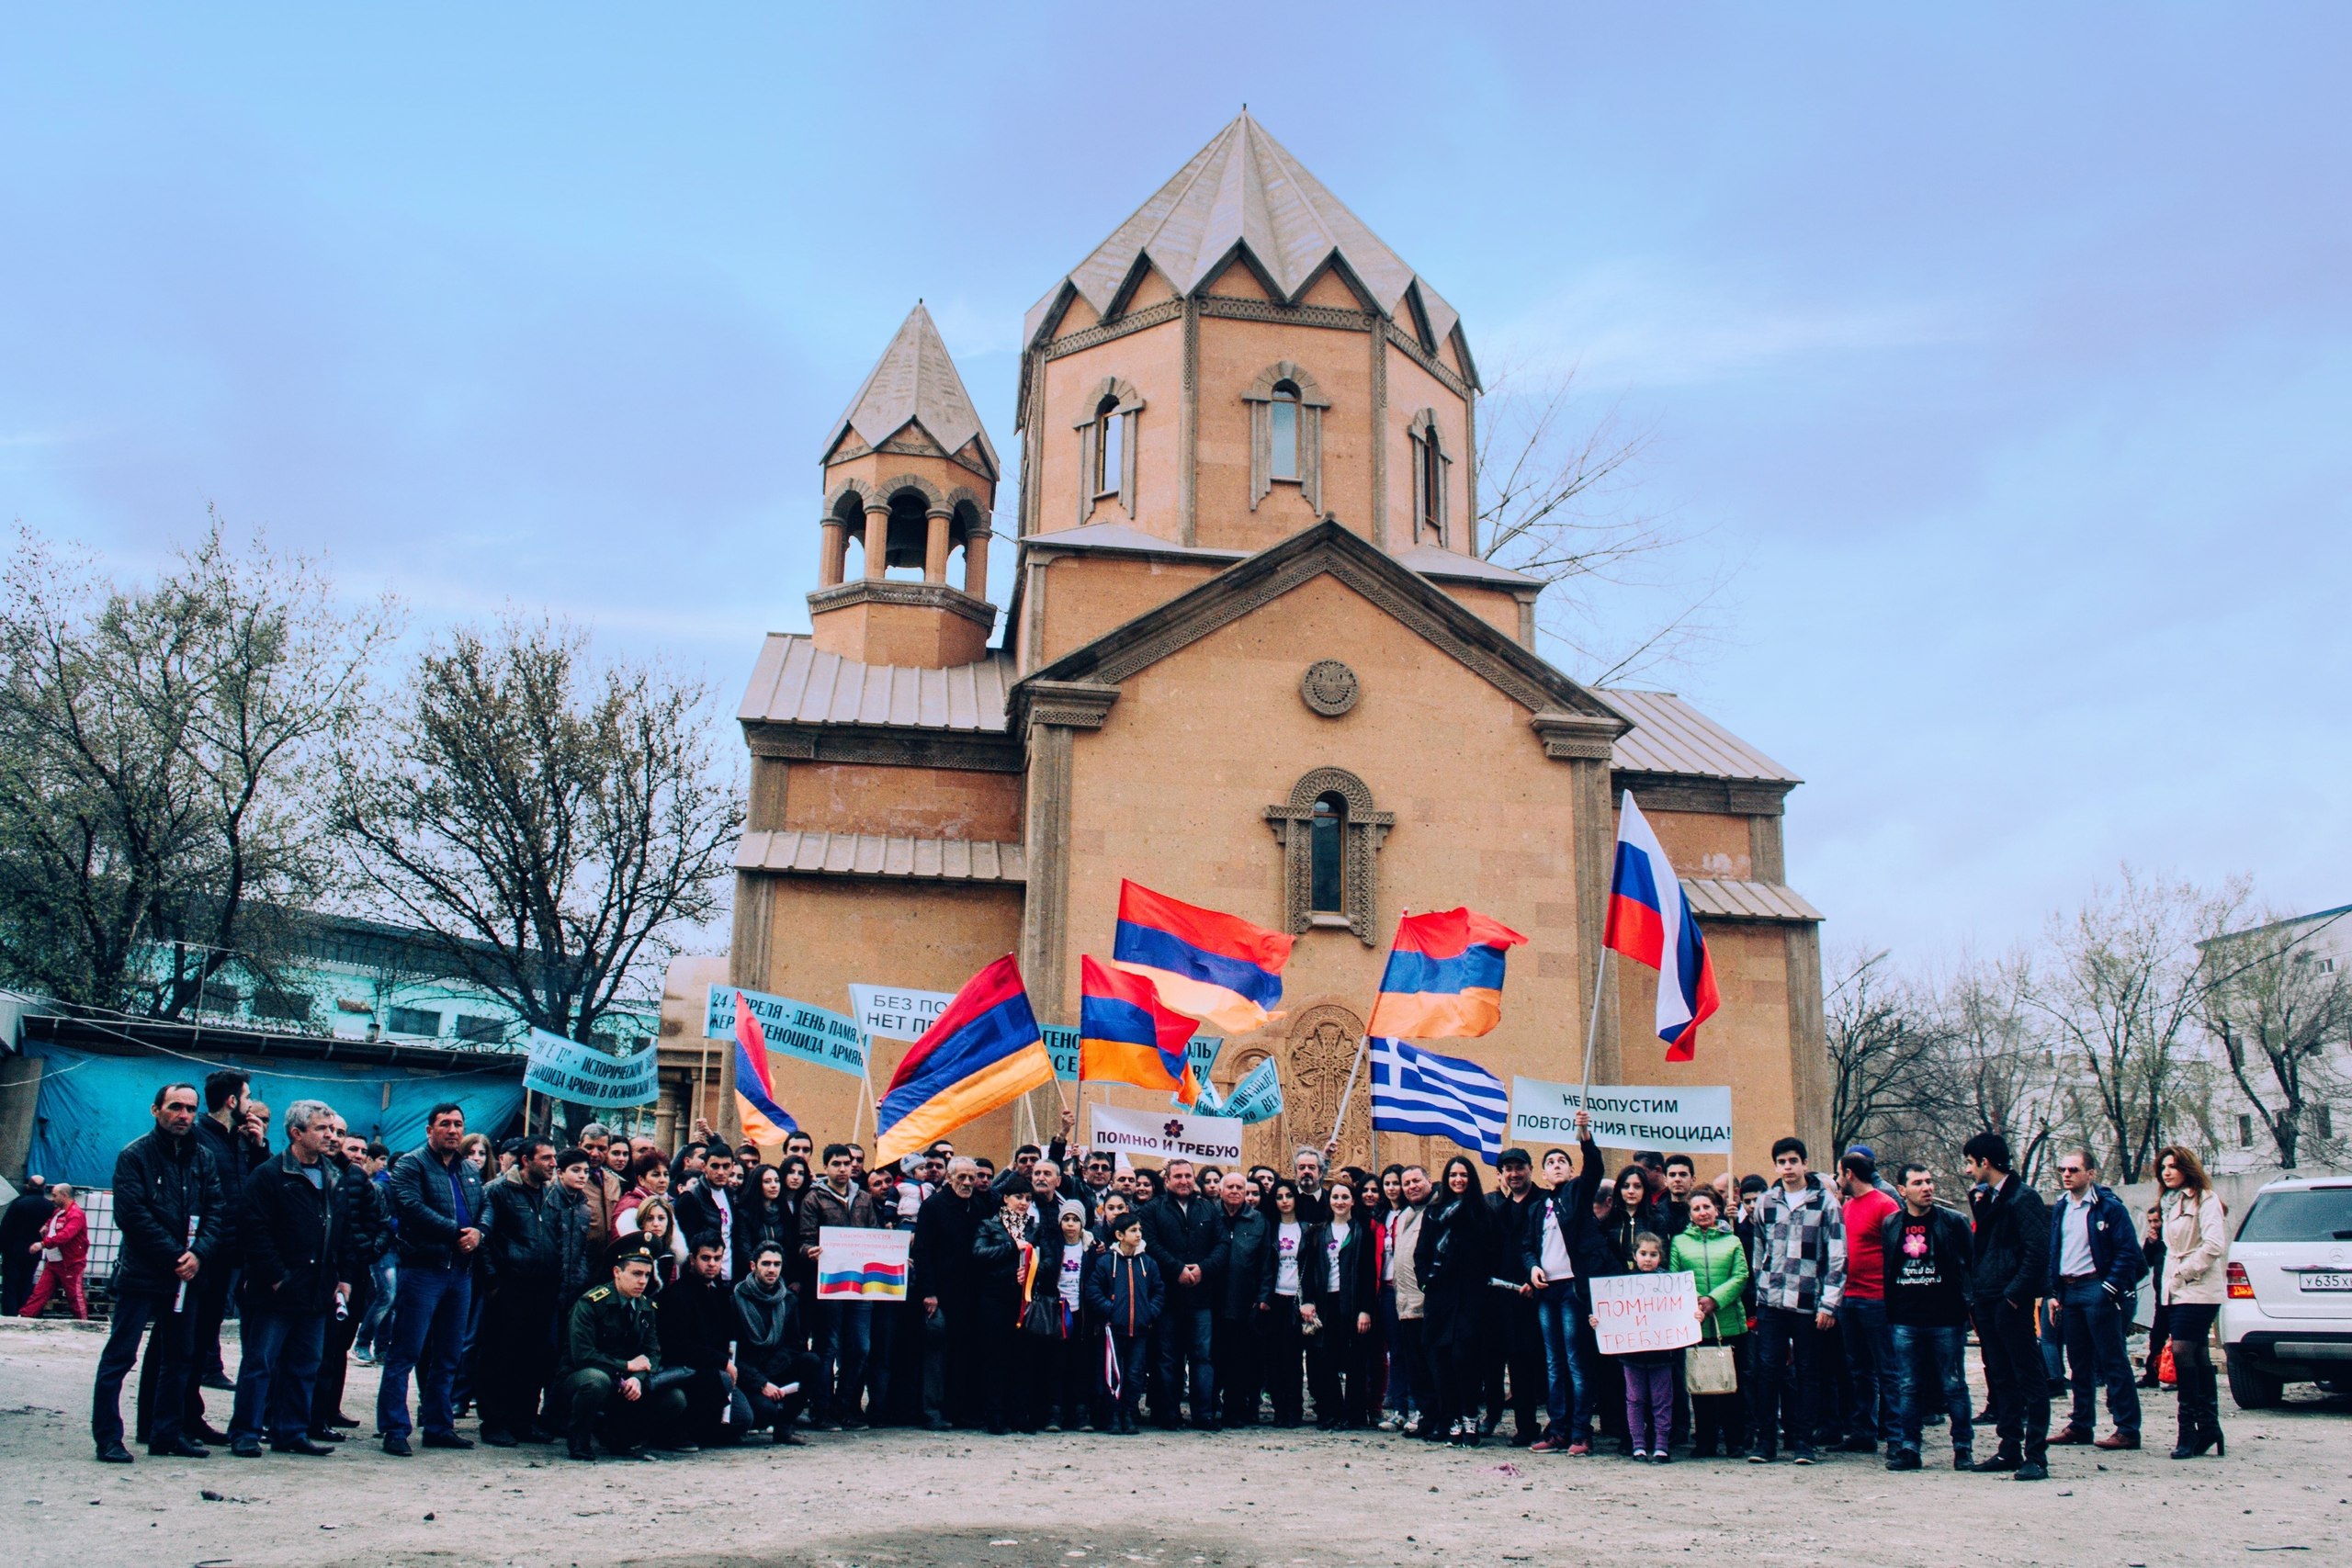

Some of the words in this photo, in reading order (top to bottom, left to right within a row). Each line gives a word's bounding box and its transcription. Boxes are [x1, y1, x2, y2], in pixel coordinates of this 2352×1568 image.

[874, 994, 912, 1011] БЕЗ
[710, 992, 729, 1009] 24
[792, 1010, 826, 1032] ДЕНЬ
[829, 1020, 868, 1047] ПАМЯИ
[866, 1011, 907, 1031] НЕТ
[566, 1075, 600, 1098] АРМЯН
[599, 1084, 608, 1099] В
[1562, 1093, 1581, 1107] НЕ
[1587, 1098, 1679, 1113] ДОПУСТИМ
[1097, 1130, 1158, 1149] ПОМНЮ
[1162, 1139, 1173, 1152] И
[1177, 1141, 1239, 1158] ТРЕБУЮ
[1630, 1123, 1731, 1143] ГЕНОЦИДА!
[1597, 1294, 1683, 1319] ПОМНИМ
[1635, 1314, 1648, 1327] И
[1602, 1325, 1689, 1350] ТРЕБУЕМ
